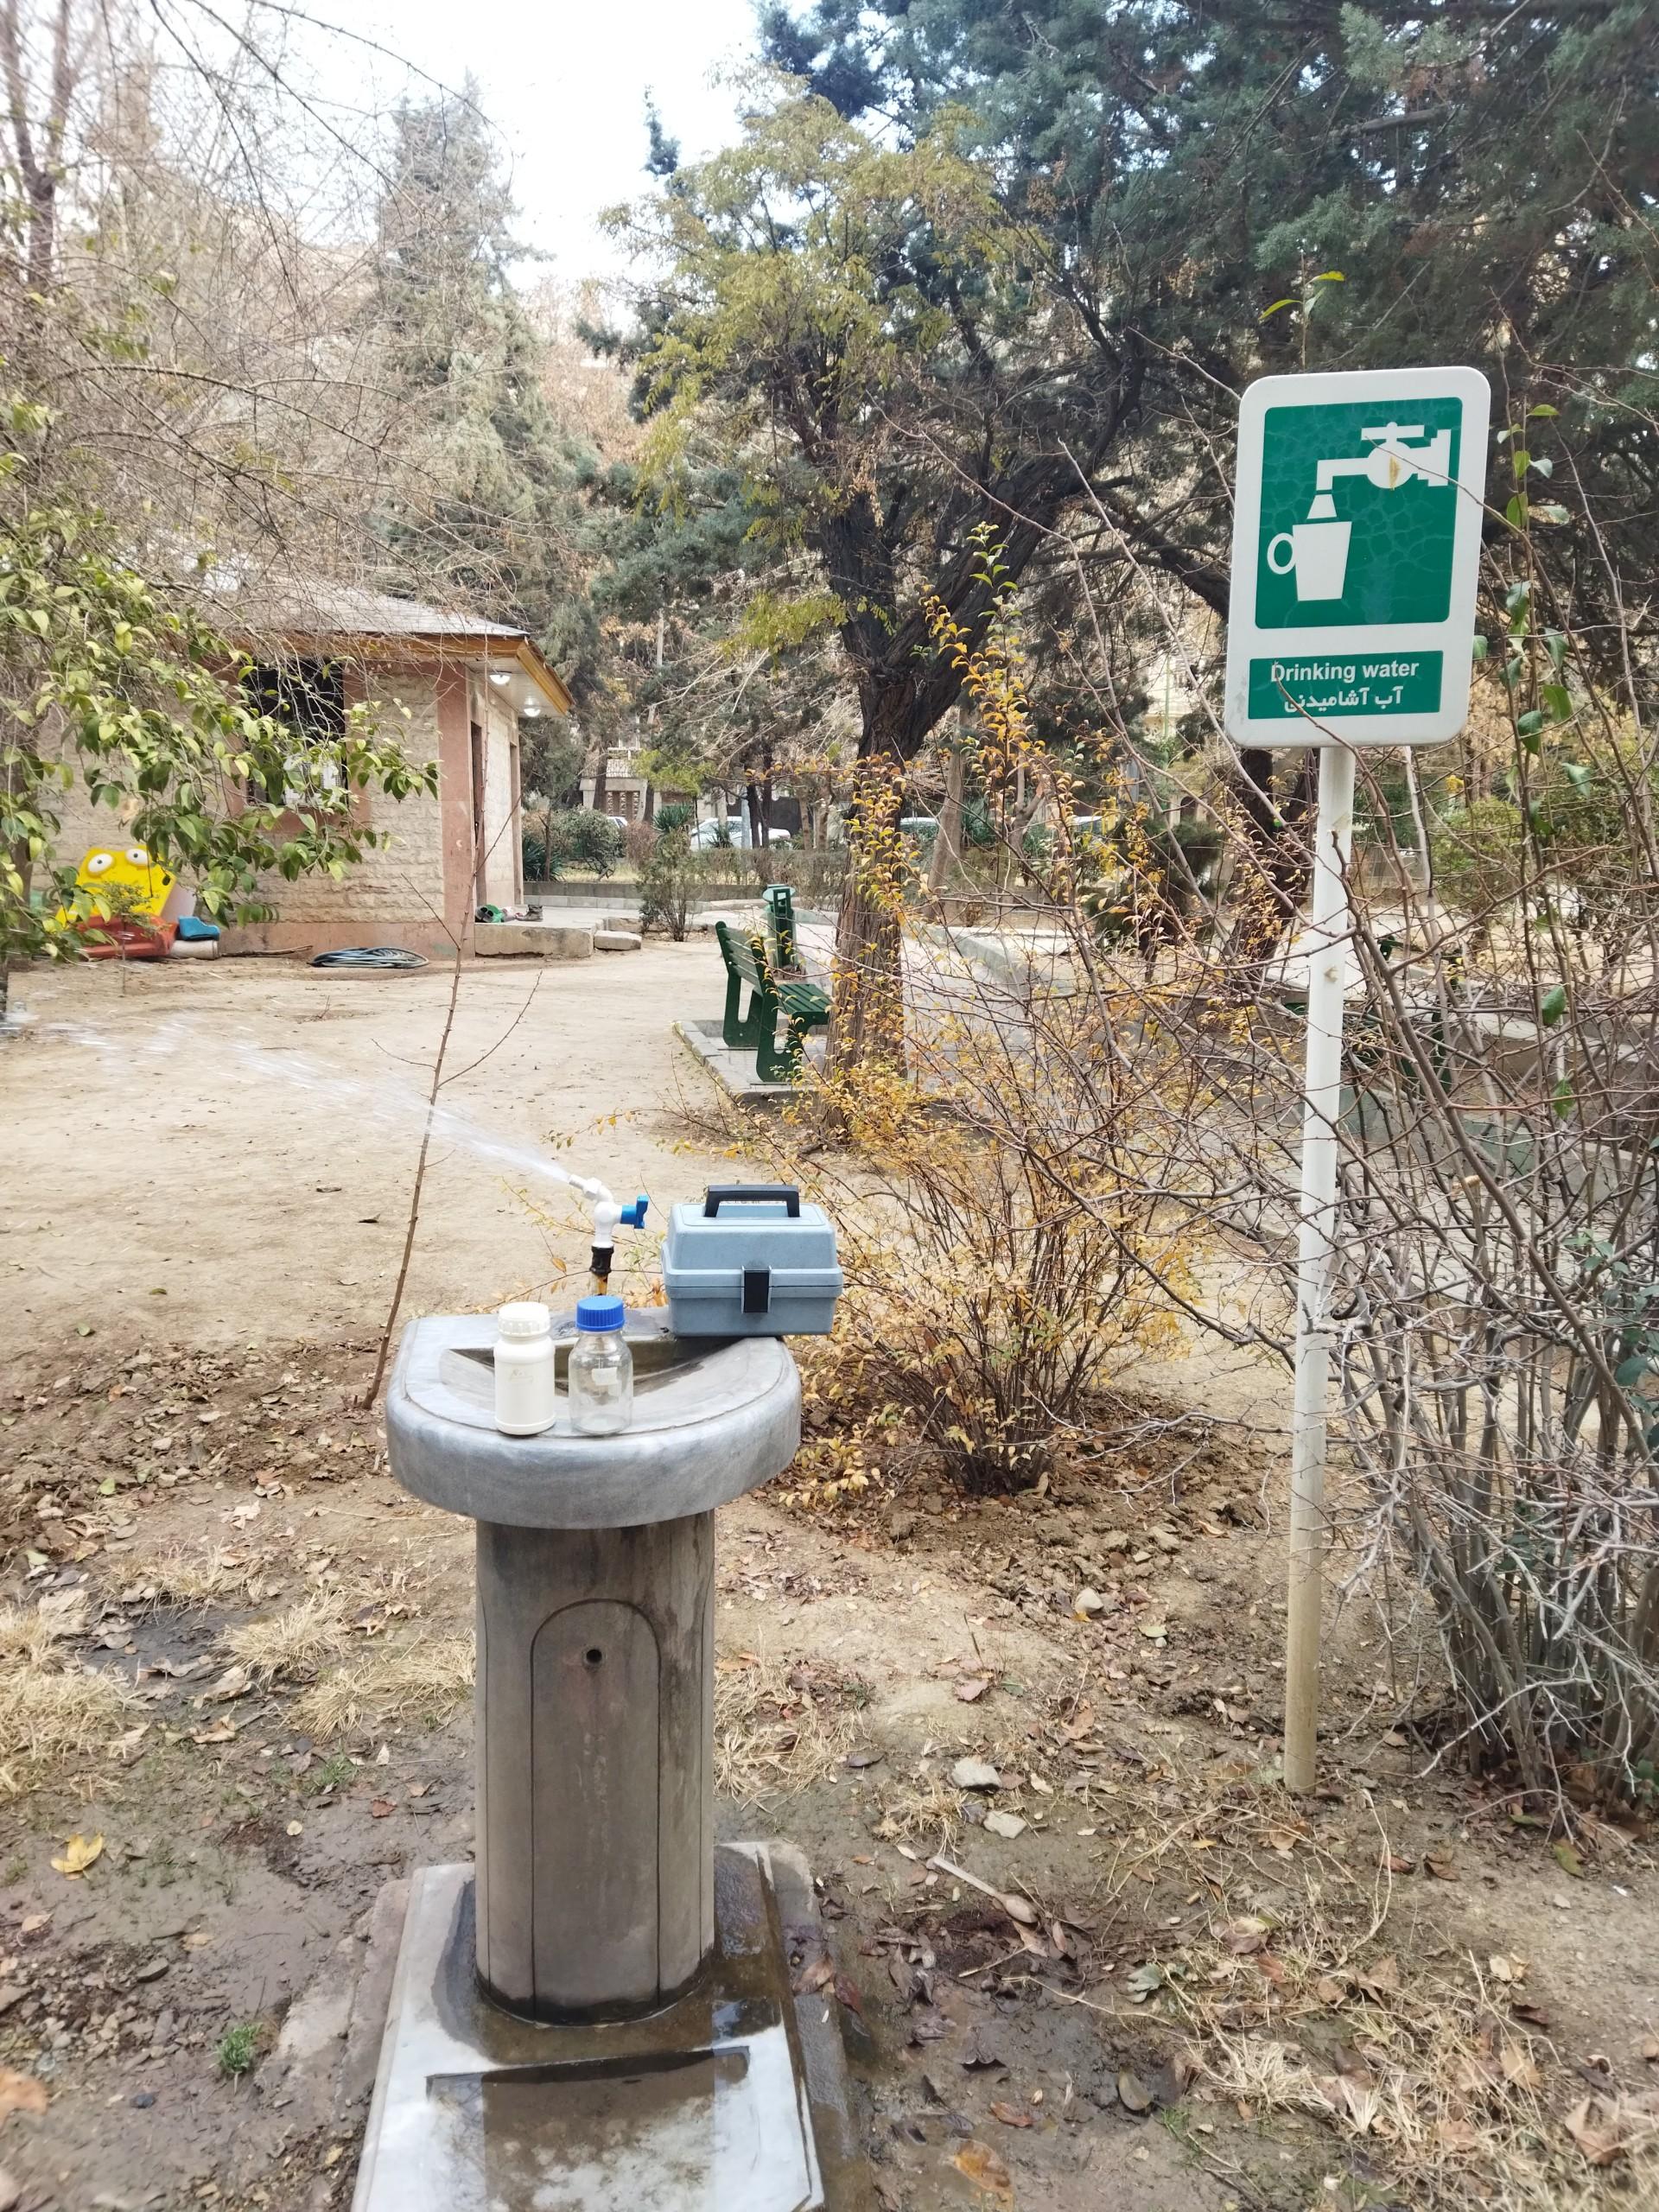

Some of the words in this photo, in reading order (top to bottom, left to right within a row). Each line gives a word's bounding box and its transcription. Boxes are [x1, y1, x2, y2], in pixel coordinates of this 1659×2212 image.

[1271, 662, 1356, 683] Drinking
[1362, 660, 1420, 678] water
[1284, 687, 1370, 713] آشامیدنی
[1375, 685, 1404, 709] آب
